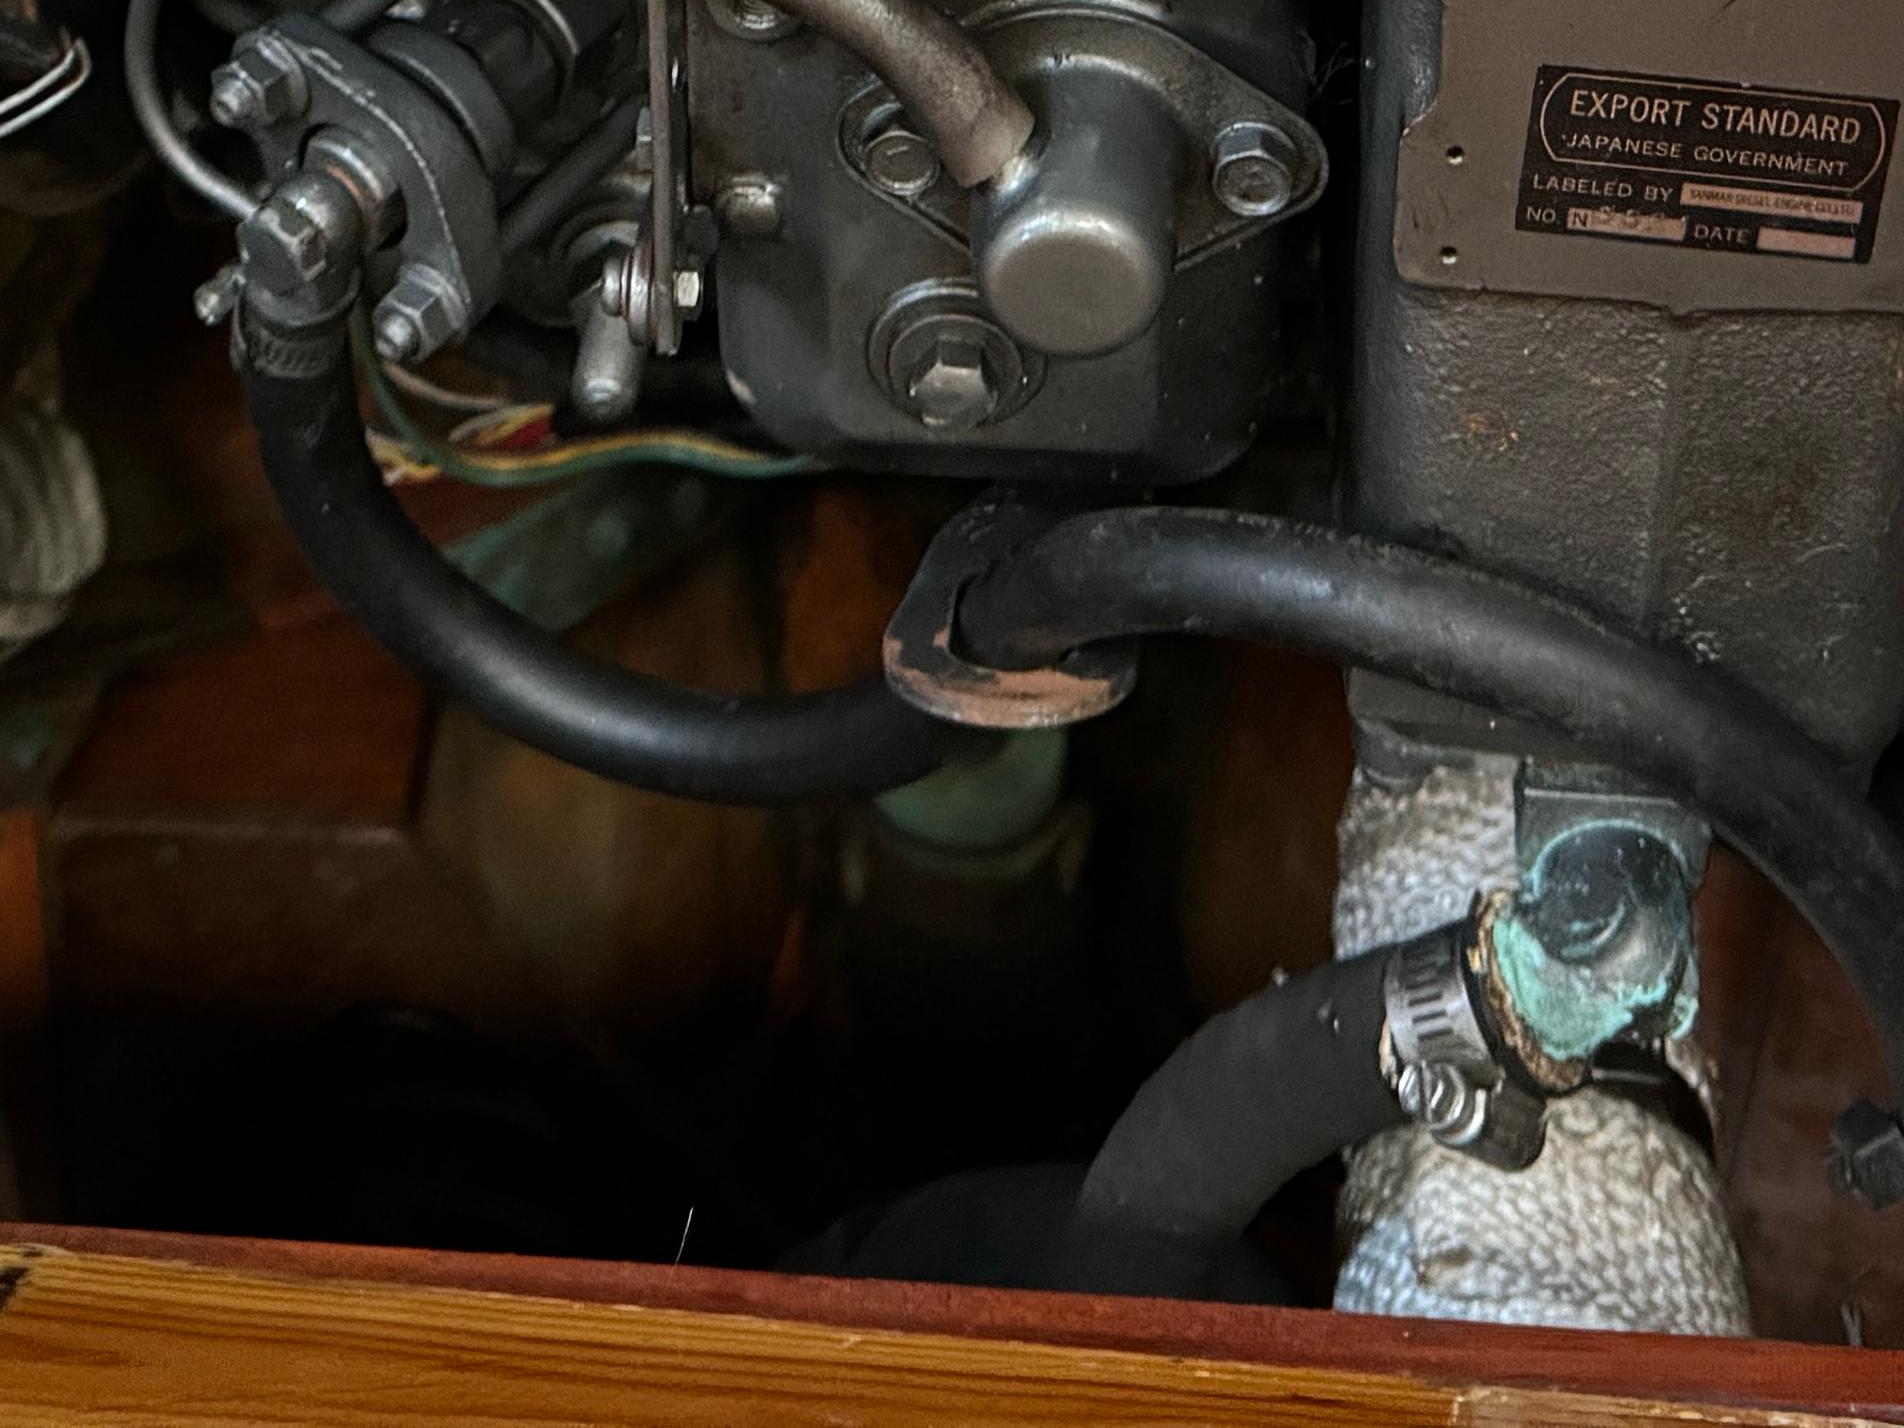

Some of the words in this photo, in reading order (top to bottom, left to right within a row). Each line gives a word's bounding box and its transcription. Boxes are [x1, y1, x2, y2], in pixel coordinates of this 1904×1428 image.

[1567, 88, 1692, 128] EXPORT
[1698, 101, 1864, 145] STANDARD
[1564, 132, 1683, 160] JAPANESE
[1691, 144, 1849, 177] GOVERNMENT
[1531, 172, 1634, 199] LABELED
[1643, 184, 1673, 203] BY
[1692, 223, 1750, 244] DATE
